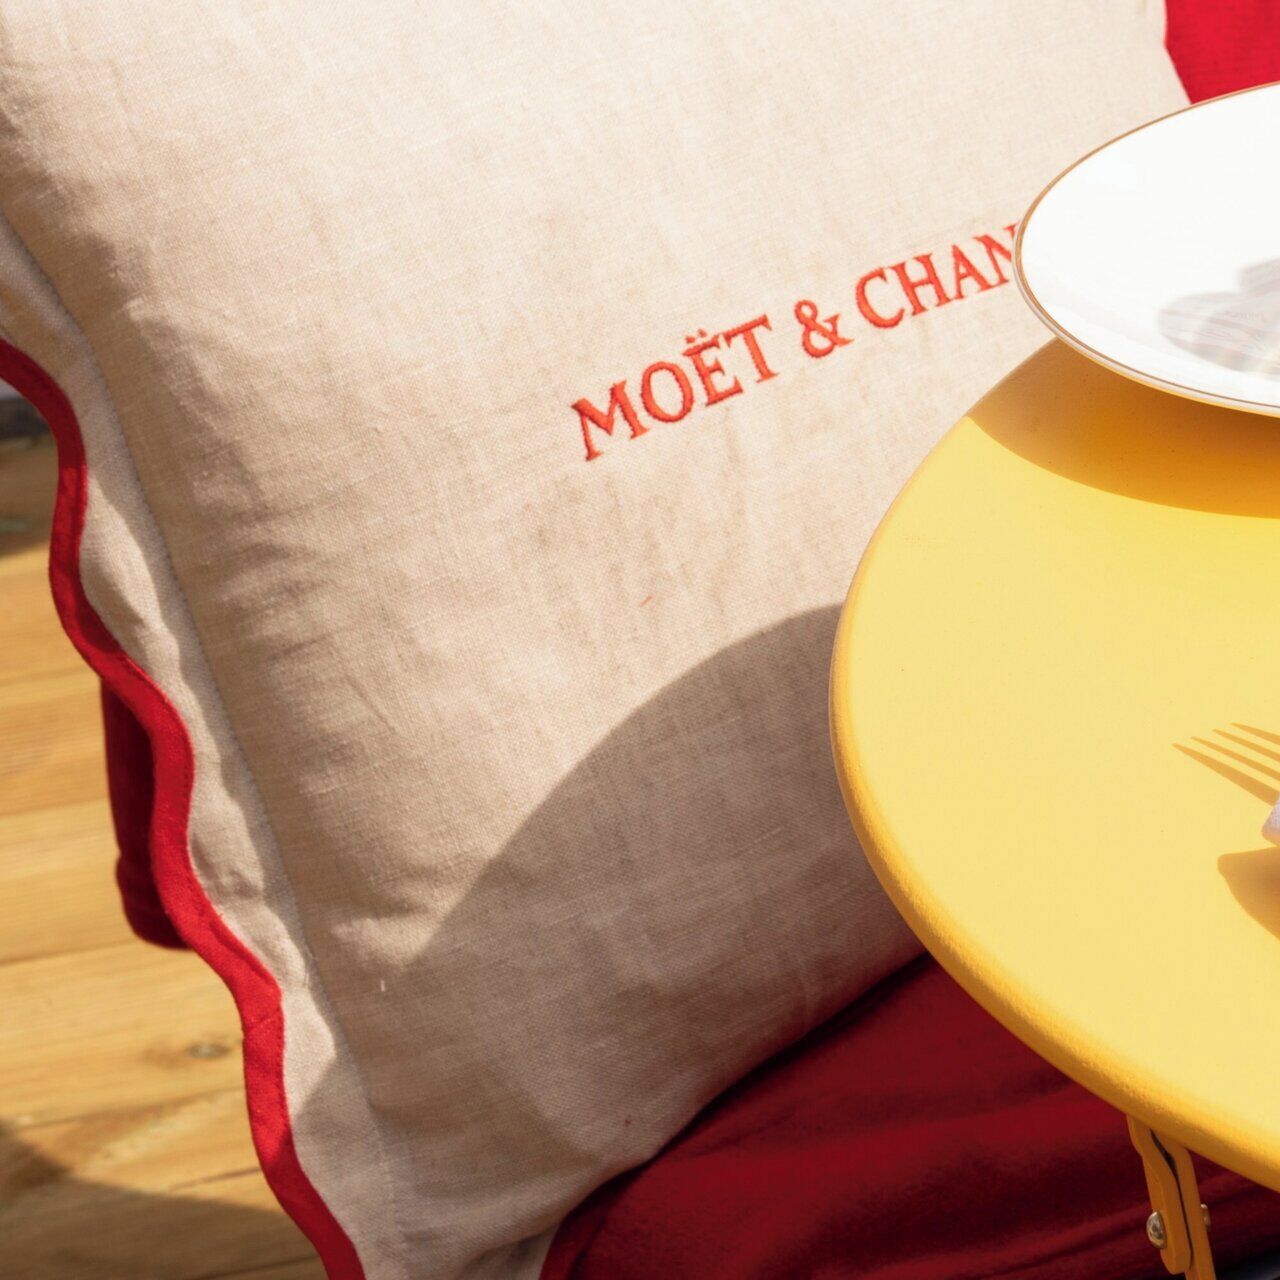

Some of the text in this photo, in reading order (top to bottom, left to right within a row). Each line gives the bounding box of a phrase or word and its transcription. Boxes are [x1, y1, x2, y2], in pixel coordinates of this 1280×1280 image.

[569, 220, 1020, 462] MOËT & CHAN
